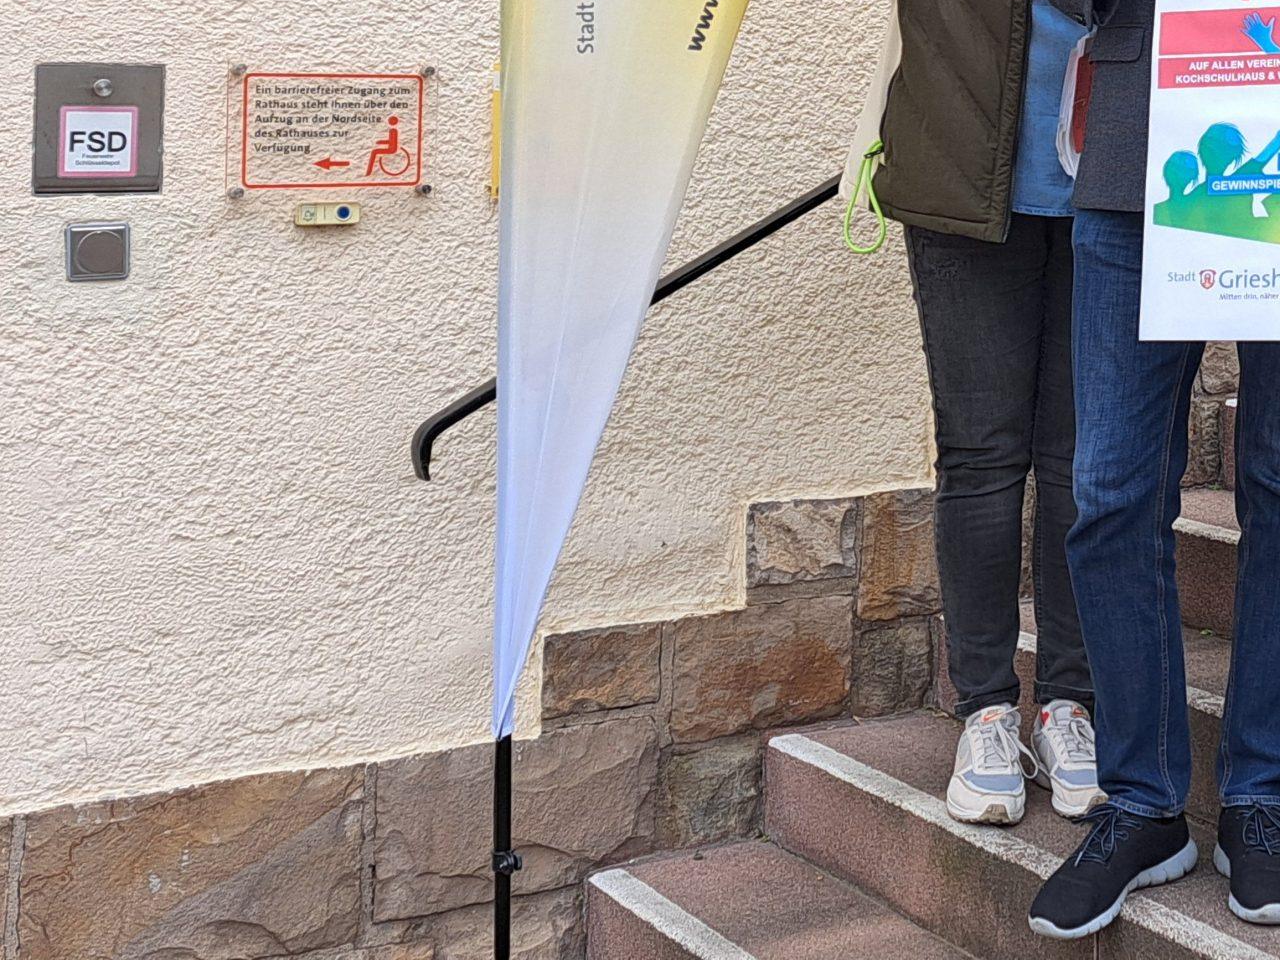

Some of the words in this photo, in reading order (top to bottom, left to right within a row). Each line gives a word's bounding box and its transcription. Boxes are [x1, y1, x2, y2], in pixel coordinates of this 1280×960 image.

[577, 1, 594, 54] Stadt
[1189, 61, 1209, 71] AUF
[1211, 60, 1244, 70] ALLEN
[1175, 71, 1265, 84] KOCHSCHULHAUS
[1268, 71, 1275, 80] &
[255, 85, 271, 94] Ein
[274, 85, 344, 95] barrierefreier
[347, 86, 385, 97] Zugang
[388, 87, 411, 95] zum
[255, 99, 298, 109] Rathaus
[301, 100, 328, 109] steht
[331, 100, 361, 109] Ihnen
[363, 100, 387, 109] über
[389, 100, 409, 109] den
[255, 115, 293, 125] Aufzug
[312, 114, 329, 123] der
[332, 114, 382, 123] Nordseite
[254, 129, 272, 138] des
[275, 128, 330, 138] Rathauses
[69, 131, 127, 152] FSD
[1167, 271, 1195, 282] Stadt
[1260, 292, 1279, 300] näher
